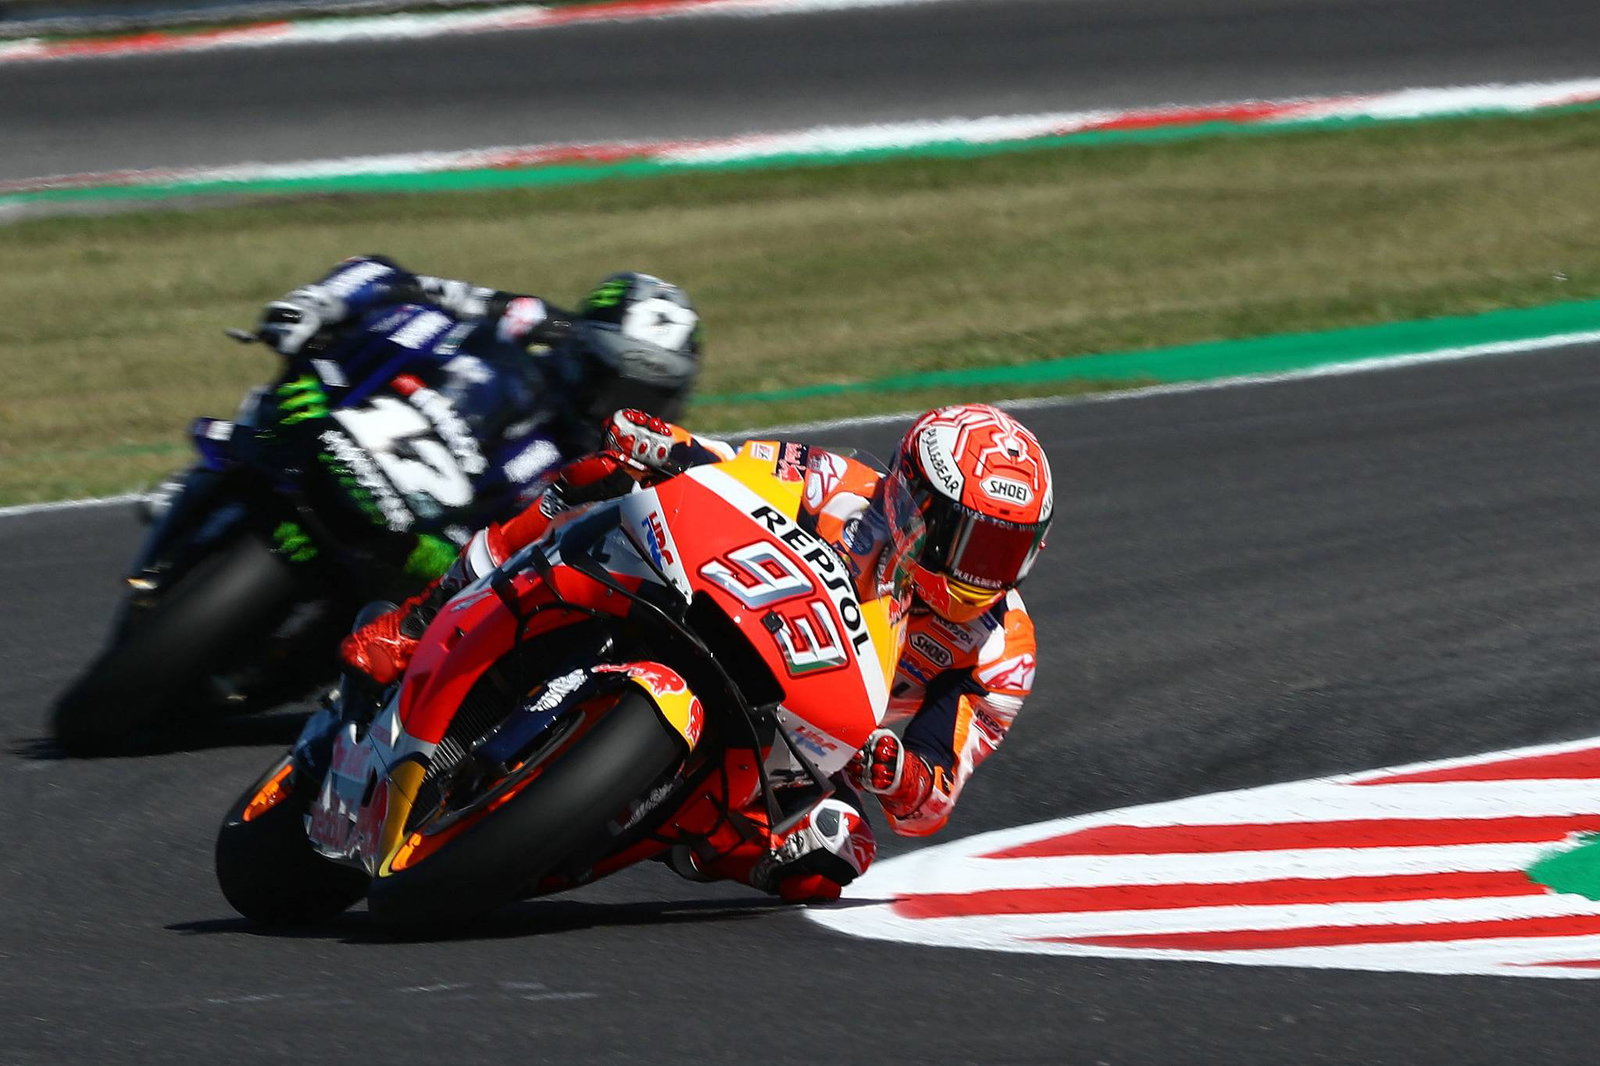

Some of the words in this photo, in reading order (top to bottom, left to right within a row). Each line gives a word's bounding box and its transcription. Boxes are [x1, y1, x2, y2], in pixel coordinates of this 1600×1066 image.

[922, 428, 960, 494] PULL&BEAR
[989, 480, 1028, 501] SHOEI
[697, 540, 849, 678] 93
[751, 505, 870, 656] REPSOL
[953, 568, 1003, 589] PULL&BEAR
